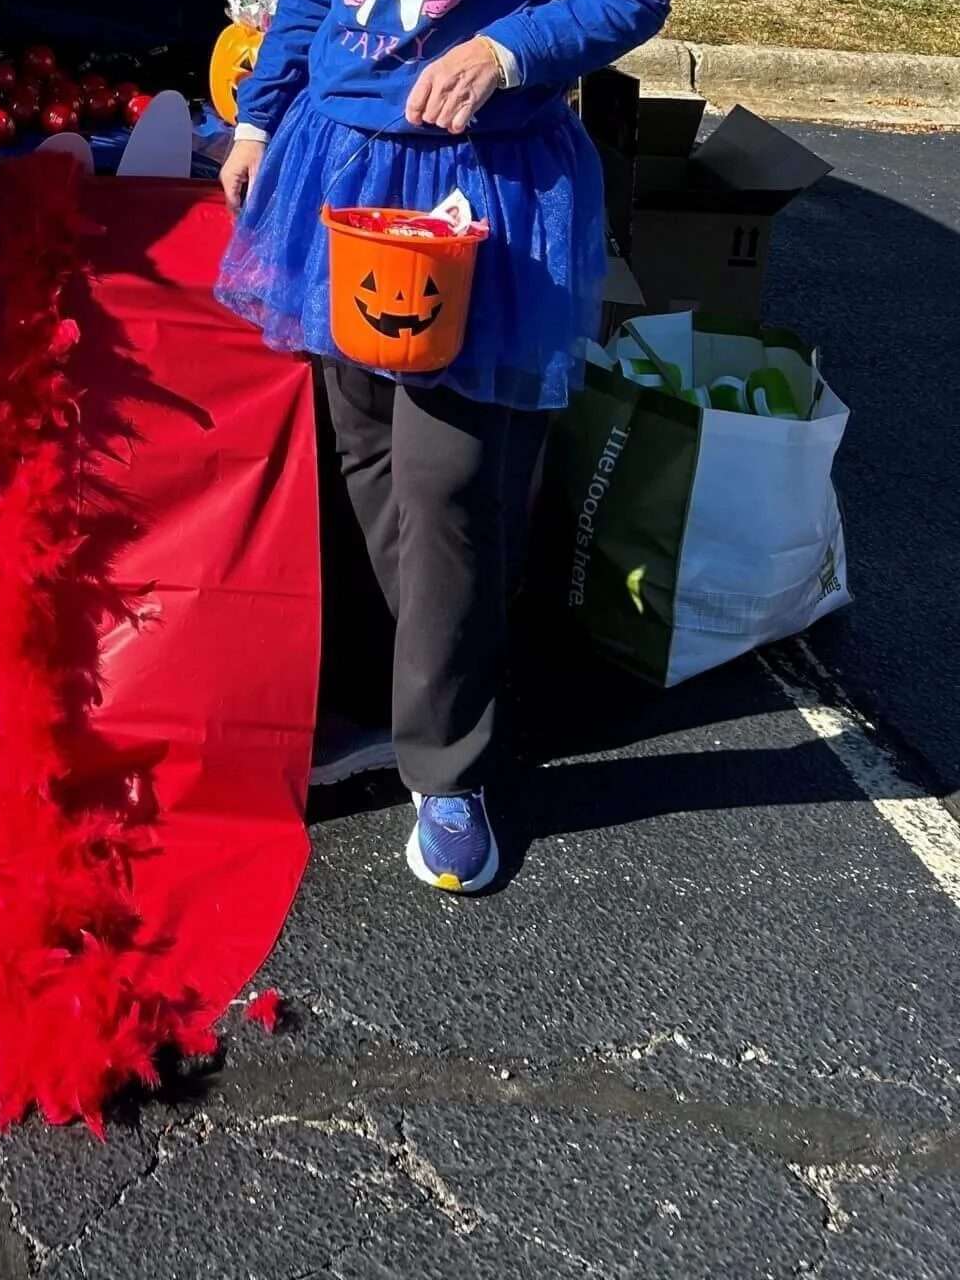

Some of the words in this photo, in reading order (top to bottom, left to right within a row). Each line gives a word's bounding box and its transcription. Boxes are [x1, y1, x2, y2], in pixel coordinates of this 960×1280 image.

[597, 425, 632, 474] The
[575, 473, 610, 547] food's
[567, 548, 592, 609] here.
